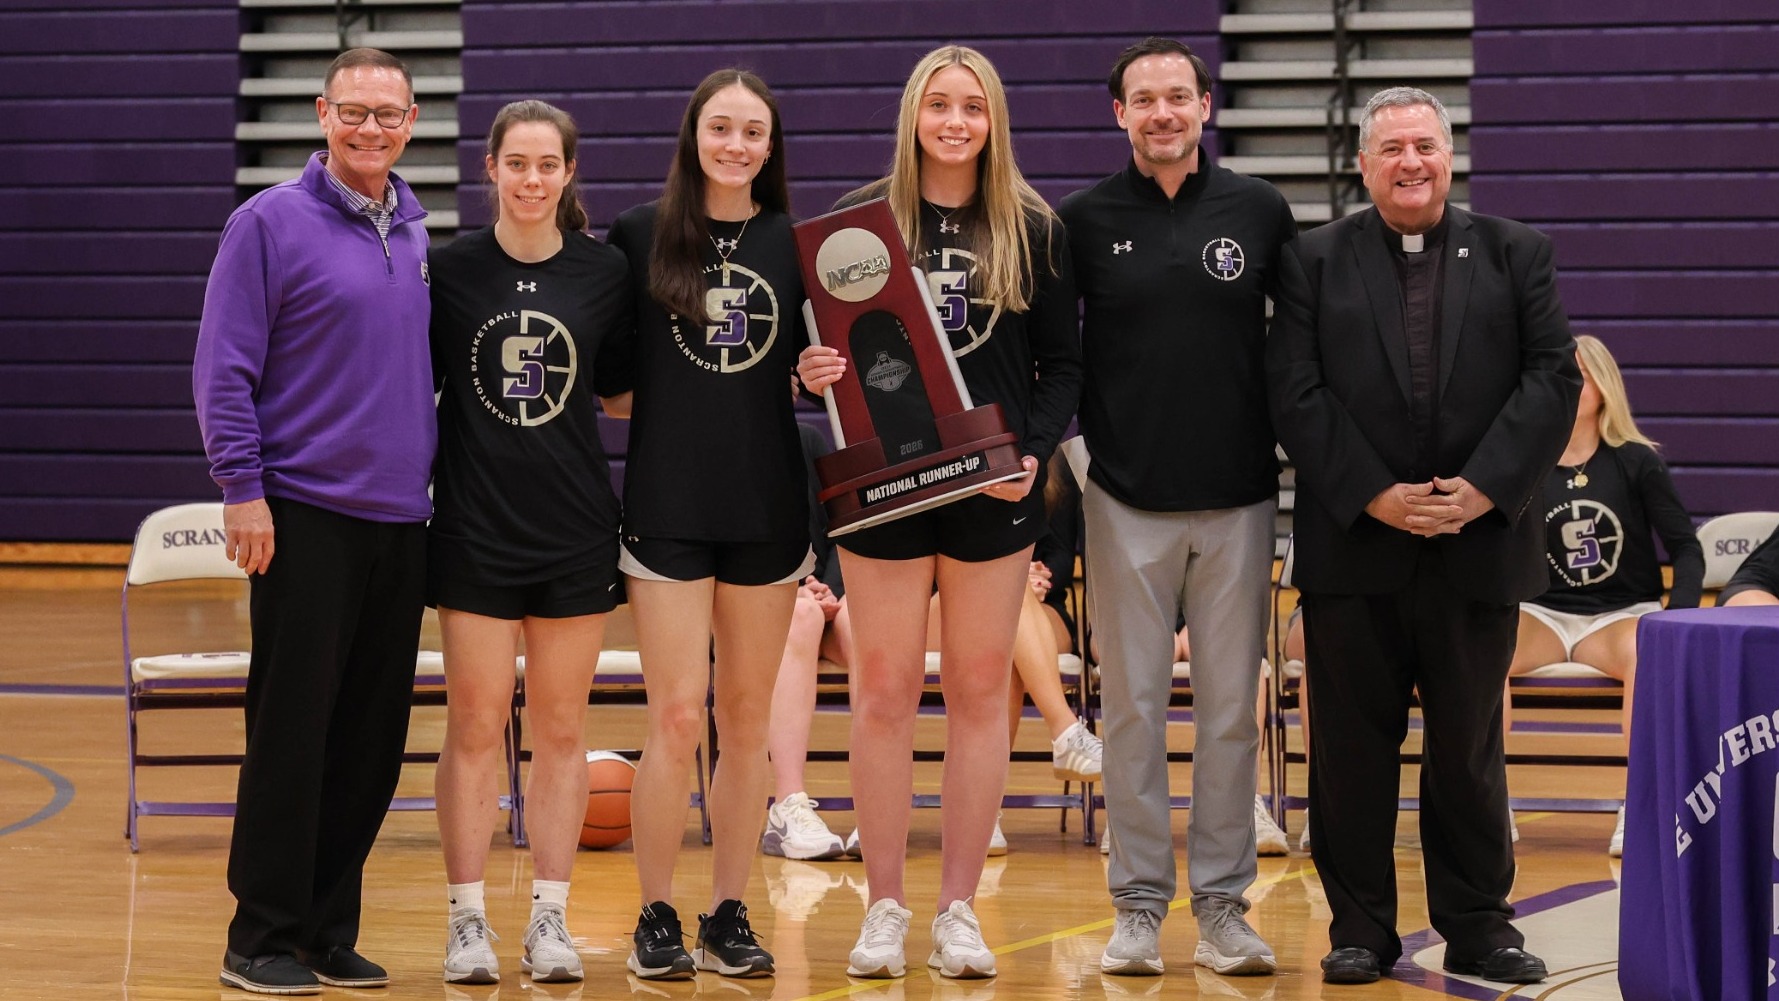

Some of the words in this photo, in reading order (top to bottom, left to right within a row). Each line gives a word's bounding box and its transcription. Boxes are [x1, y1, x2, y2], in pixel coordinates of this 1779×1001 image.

[826, 254, 890, 292] NCAA
[705, 287, 748, 346] S
[470, 310, 519, 372] BASKETBALL
[671, 325, 720, 373] SCRANTON
[502, 335, 545, 399] S
[472, 377, 519, 426] SCRANTON
[900, 440, 923, 456] 2026
[866, 475, 918, 503] NATIONAL
[918, 456, 980, 486] RUNNER-UP
[162, 528, 227, 550] SCRAN
[1561, 518, 1601, 570] S
